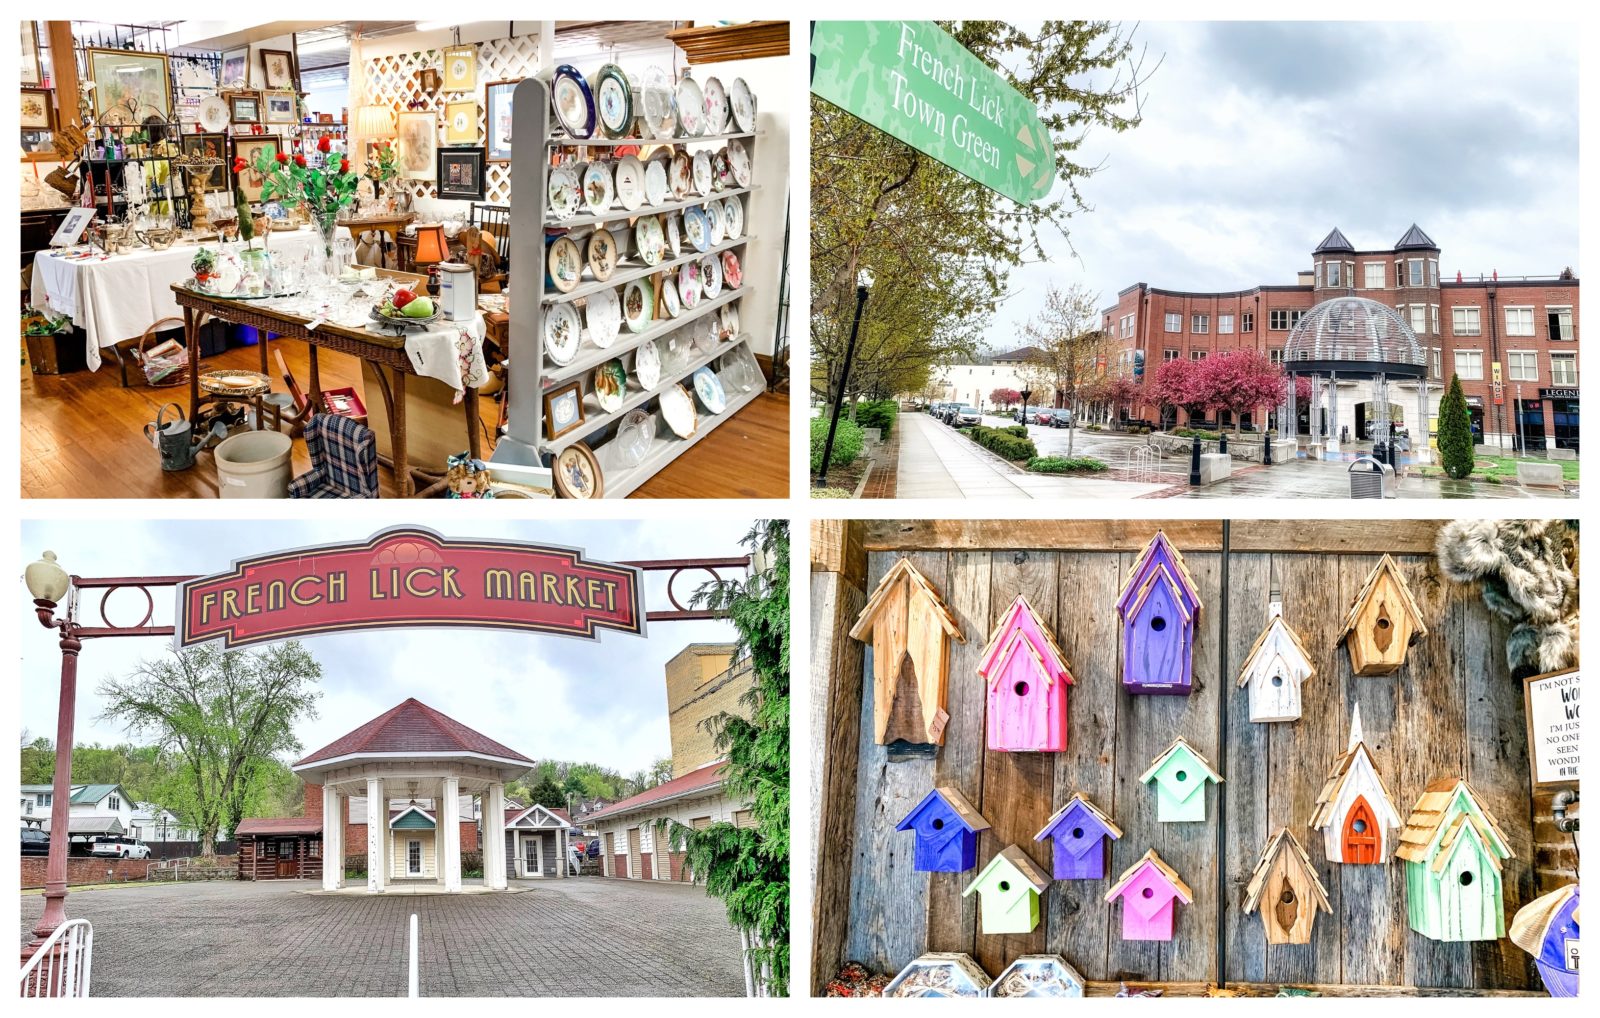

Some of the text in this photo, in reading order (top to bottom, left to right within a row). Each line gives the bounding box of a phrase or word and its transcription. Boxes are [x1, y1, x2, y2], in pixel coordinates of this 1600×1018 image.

[897, 22, 1006, 128] French Lick
[890, 70, 1001, 170] Town Green
[200, 565, 619, 625] FRENCH LICK MARKET
[1554, 677, 1573, 688] NOT
[1546, 735, 1560, 744] NO
[1556, 744, 1578, 754] SEEN
[1567, 766, 1578, 776] THE
